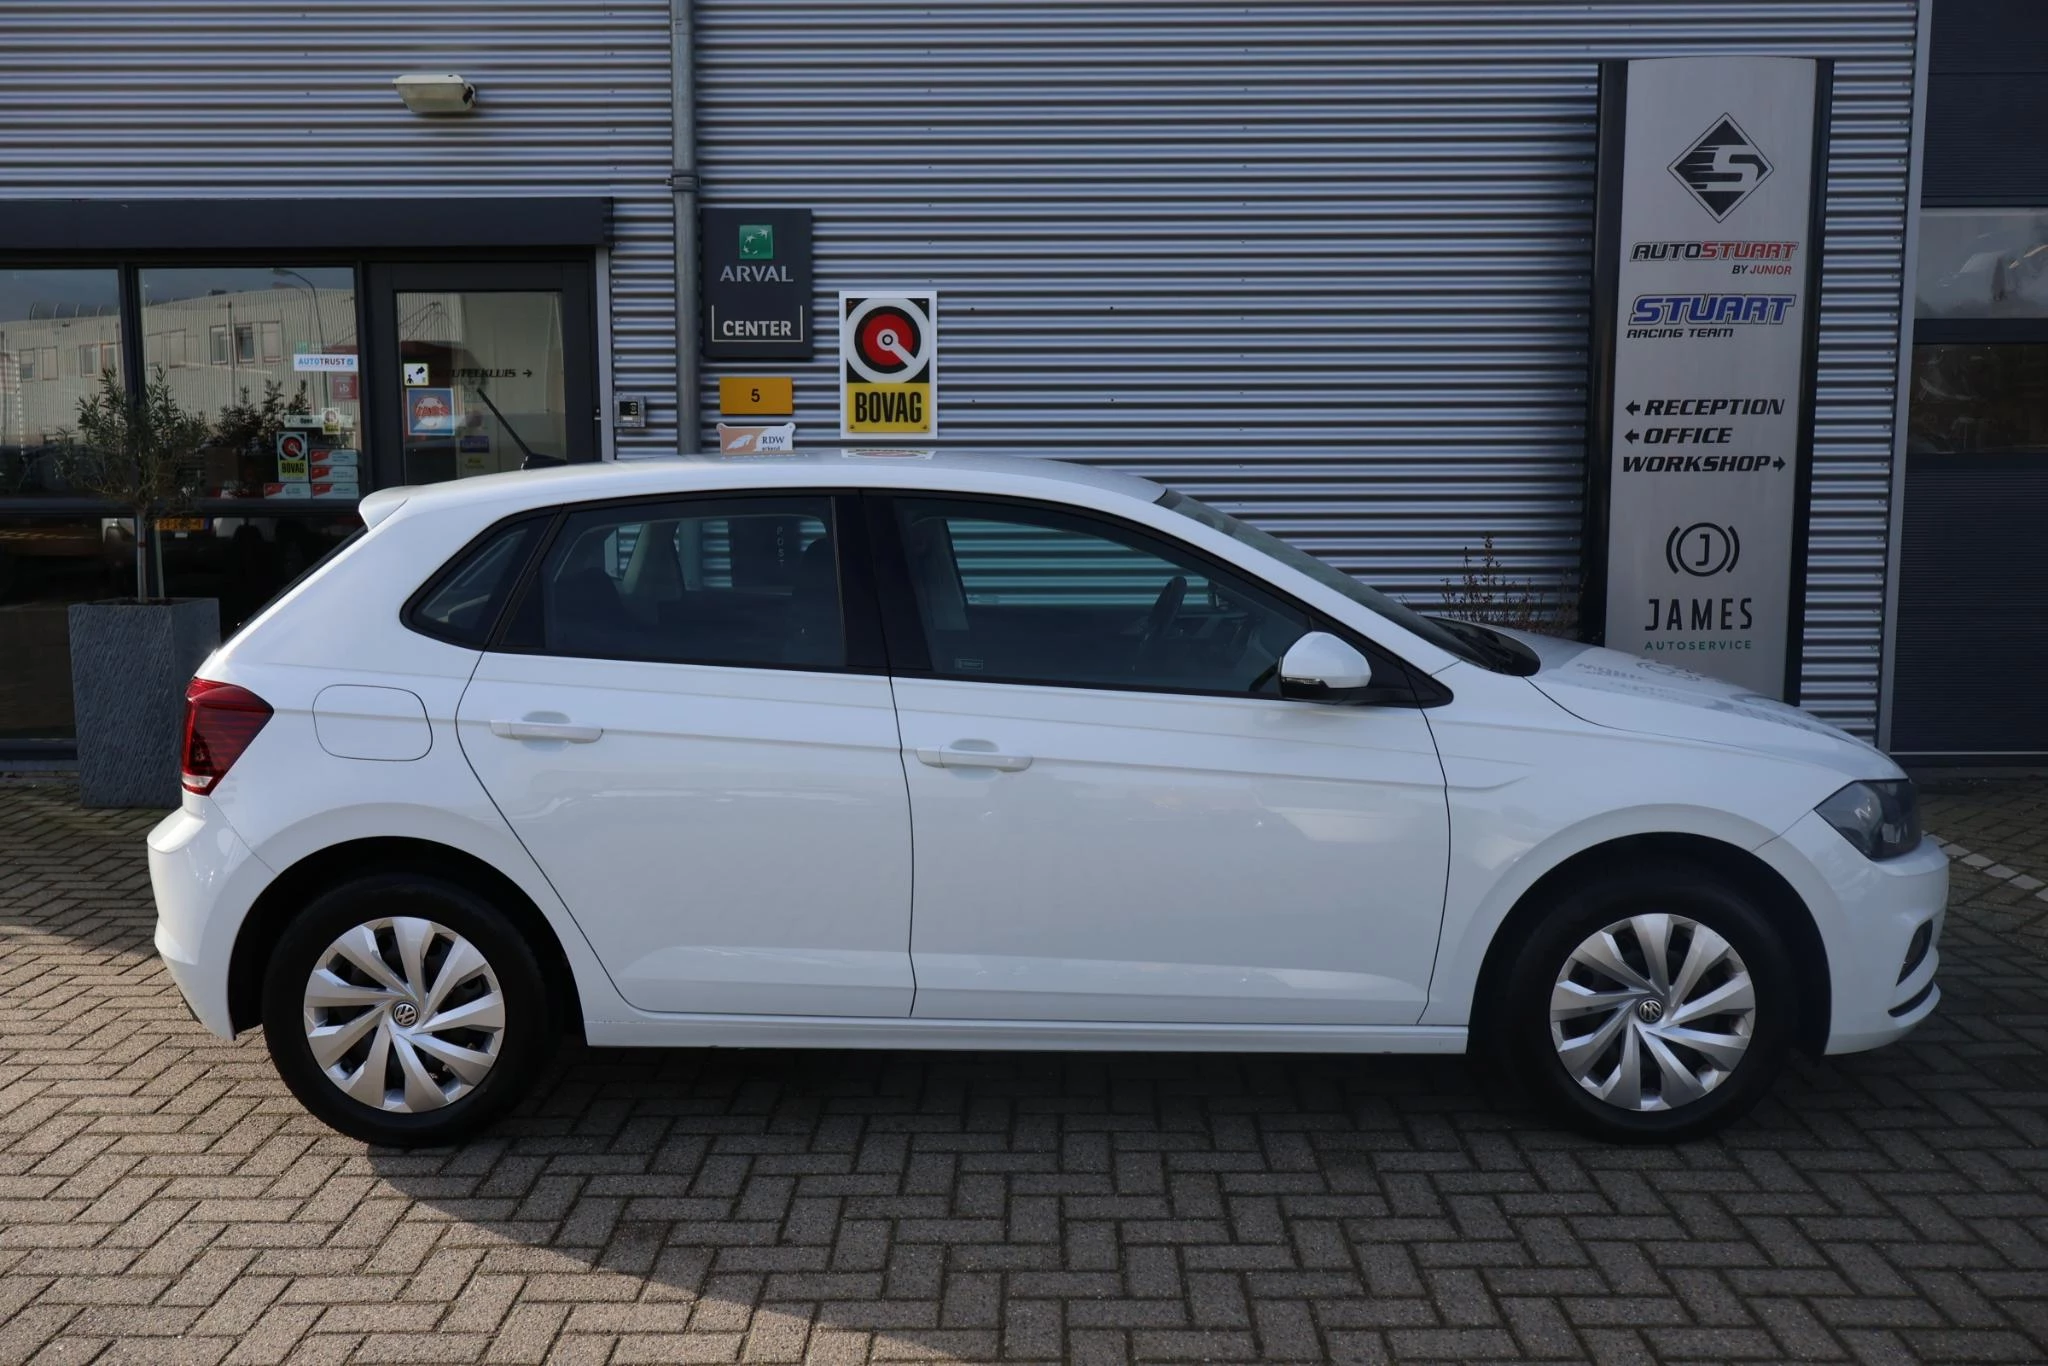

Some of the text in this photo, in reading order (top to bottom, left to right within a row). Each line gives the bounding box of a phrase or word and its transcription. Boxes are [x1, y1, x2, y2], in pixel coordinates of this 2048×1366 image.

[1630, 241, 1799, 262] AUTOSTUART
[720, 265, 794, 282] ARVAL
[1732, 265, 1792, 275] BY JUNIOR
[1628, 294, 1796, 326] STUART
[723, 320, 792, 337] CENTER
[1627, 328, 1734, 339] RACING TEAM
[298, 357, 345, 366] AUTOTRUST
[750, 389, 760, 404] 5
[855, 391, 923, 424] BOVAG
[1645, 398, 1785, 415] RECEPTION
[762, 435, 785, 445] RDW
[1643, 427, 1734, 445] OFFICE
[281, 462, 305, 474] BOVAG
[1623, 455, 1770, 473] WORKSHOP
[1644, 597, 1753, 631] JAMES
[1644, 639, 1752, 651] AUTOSERVICE
